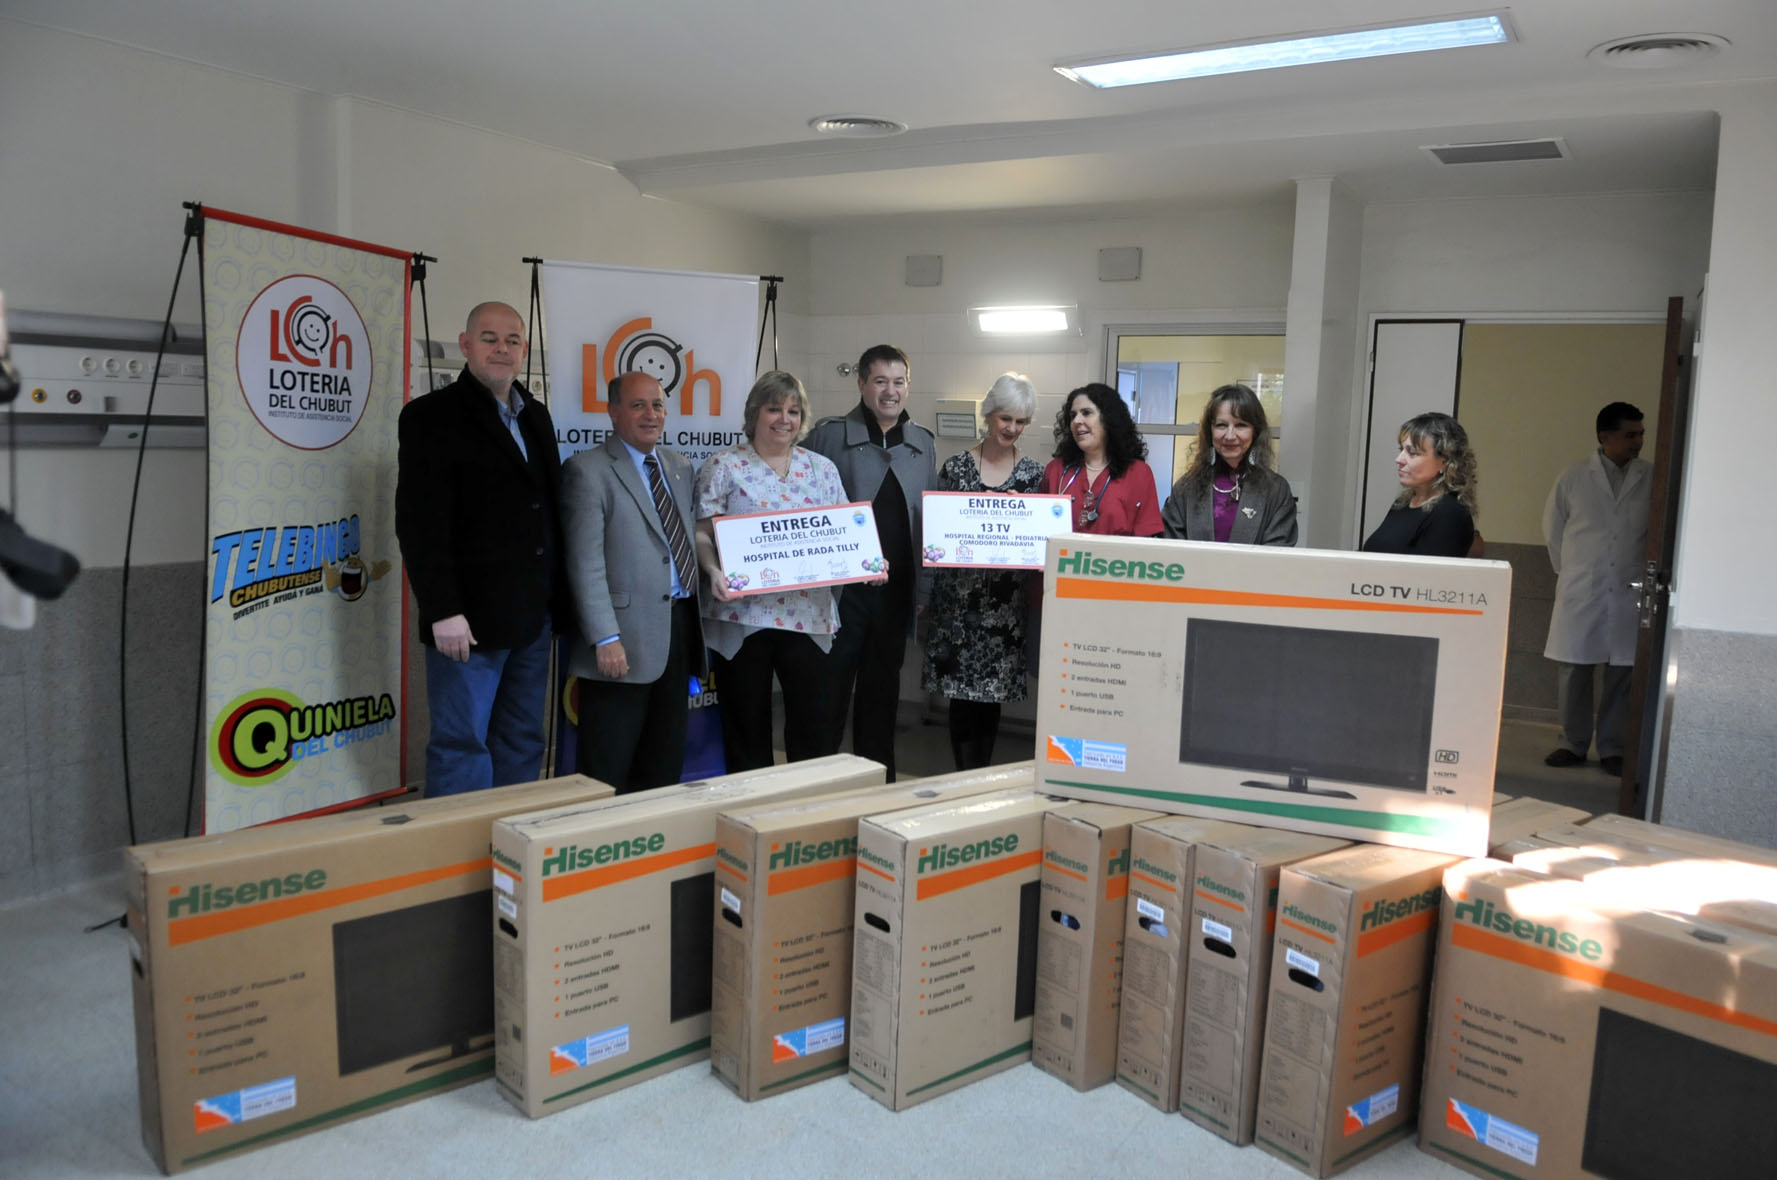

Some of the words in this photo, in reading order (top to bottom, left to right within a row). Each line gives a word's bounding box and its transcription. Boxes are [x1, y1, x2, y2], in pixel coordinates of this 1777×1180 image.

[269, 368, 352, 396] LOTERIA
[269, 393, 295, 409] DEL
[299, 396, 352, 413] CHUBUT
[677, 431, 743, 446] CHUBUT
[969, 498, 1026, 510] ENTREGA
[750, 534, 788, 544] LOTERIA
[791, 531, 808, 540] DEL
[810, 526, 847, 538] CHUBUT
[761, 515, 832, 534] ENTREGA
[981, 523, 993, 532] 13
[996, 524, 1010, 532] TV
[211, 514, 360, 604] TELEBINGO
[744, 550, 790, 562] HOSPITAL
[792, 548, 806, 558] DE
[808, 546, 834, 556] RADA
[836, 542, 860, 552] TILLY
[1058, 549, 1185, 582] Hisense
[231, 569, 322, 607] CHUBUTENSE
[1350, 583, 1384, 597] LCD
[1390, 586, 1411, 599] TV
[1416, 587, 1488, 606] HL3211A
[233, 599, 270, 621] DIVERTITE
[1117, 648, 1145, 656] Formato
[1077, 676, 1105, 684] entradas
[1070, 705, 1095, 714] Entrada
[232, 694, 396, 771] QUINIELA
[292, 736, 328, 760] DEL
[334, 720, 392, 748] CHUBUT
[542, 833, 665, 876] Hisense
[857, 843, 895, 871] Hisense
[918, 833, 1018, 874] Hisense
[1045, 844, 1088, 873] Hisense
[1133, 853, 1176, 882] Hisense
[168, 869, 328, 918] Hisense
[1196, 872, 1246, 902] Hisense
[1282, 899, 1337, 934] Hisense
[1455, 892, 1602, 961] Hisense
